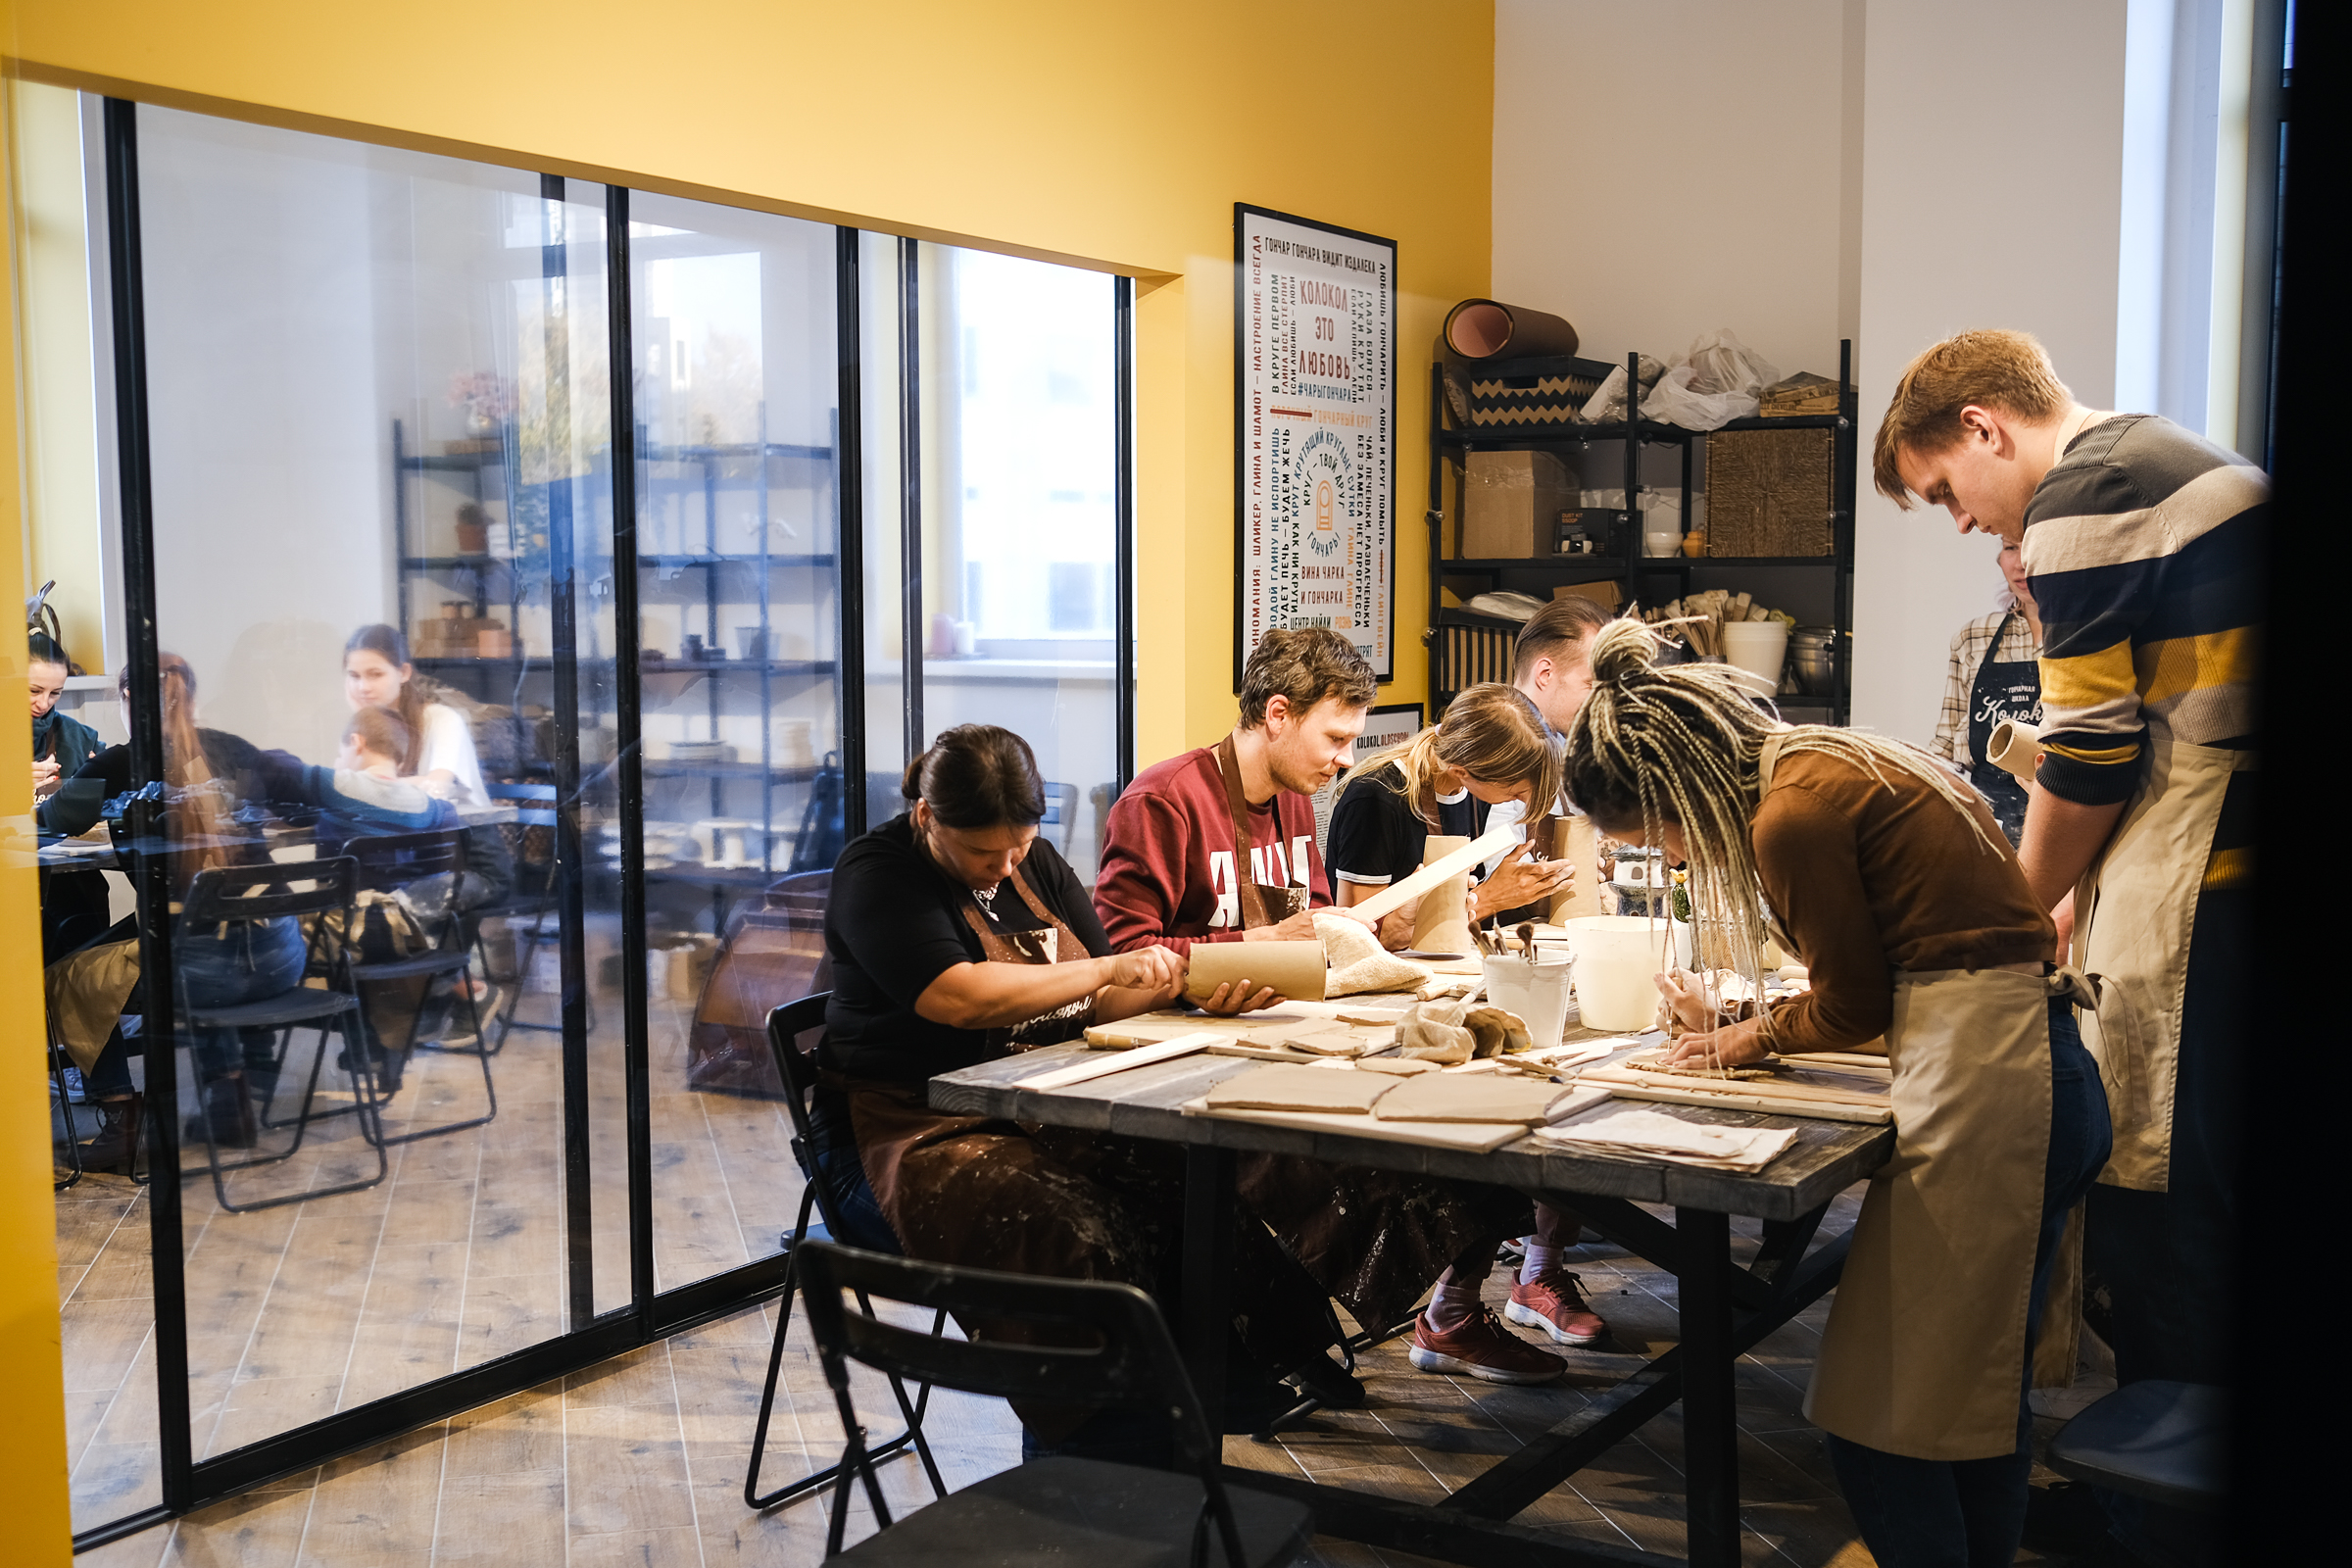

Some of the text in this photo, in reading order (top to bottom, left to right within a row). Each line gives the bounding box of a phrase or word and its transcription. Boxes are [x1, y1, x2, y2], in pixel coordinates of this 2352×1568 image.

[1252, 235, 1262, 285] ВСЕГДА
[1265, 236, 1376, 274] ГОНЧАР ГОНЧАРА ВИДИТ ИЗДАЛЕКА
[1299, 279, 1348, 313] КОЛОКОЛ
[1252, 290, 1261, 371] НАСТРОЕНИЕ
[1271, 273, 1280, 394] В КРУГЕ ПЕРВОМ
[1314, 316, 1335, 342] ЭТО
[1298, 349, 1350, 380] ЛЮБОВЬ
[1298, 381, 1351, 403] #ЧАРЫГОНЧАРА
[1252, 389, 1262, 436] ШАМОТ
[1314, 409, 1355, 427] ГОНЧАРНЫЙ
[1252, 441, 1261, 450] И
[1282, 428, 1291, 467] ЖЕЧЬ
[1379, 447, 1387, 456] И
[1252, 455, 1261, 496] ГЛИНА
[1271, 427, 1280, 511] ИСПОРТИШЬ
[1294, 426, 1324, 480] КРУТЯЩИЙ
[1325, 430, 1351, 473] КРУГЛЫЕ
[1347, 474, 1355, 517] СУТКИ
[1303, 470, 1313, 506] КРУГ
[1319, 453, 1339, 473] ТВОЙ
[1334, 474, 1346, 509] ДРУГ
[1282, 474, 1291, 523] БУДЕМ
[1271, 516, 1279, 532] НЕ
[1270, 537, 1279, 581] ГЛИНУ
[1281, 543, 1290, 578] ПЕЧЬ
[1306, 530, 1342, 558] ГОНЧАРЫ
[1291, 522, 1300, 613] КАК НИ КРУТИ
[1301, 565, 1346, 580] ВИНА ЧАРКА
[1363, 535, 1372, 628] РАЗВЛЕЧЕНЬКИ
[1251, 564, 1261, 653] ИНОМАНИЯ:
[1280, 584, 1289, 630] БУДЕТ
[1300, 590, 1344, 605] И ГОНЧАРКА
[1346, 572, 1354, 610] ГЛИНЕ
[1354, 552, 1363, 627] ПРОГРЕССА
[1290, 612, 1332, 630] ЦЕНТР НАЙДИ
[1376, 584, 1385, 658] ГЛИНТВЕЙН
[2008, 685, 2036, 694] ГОНЧАРНАЯ
[1975, 695, 2043, 729] Колок
